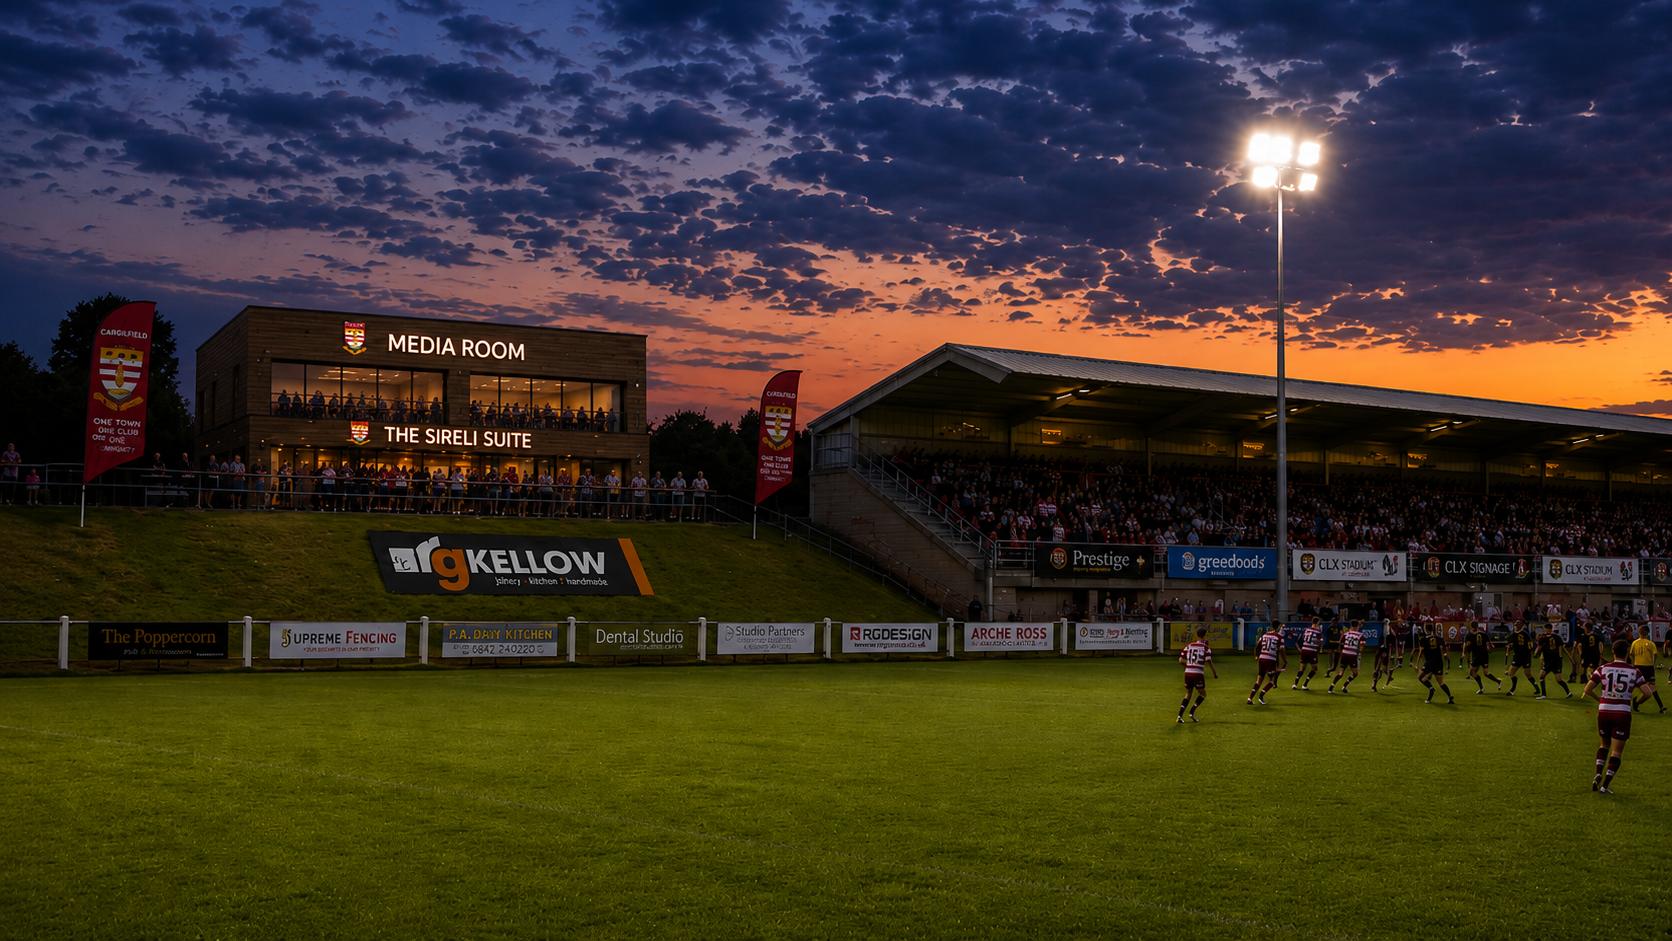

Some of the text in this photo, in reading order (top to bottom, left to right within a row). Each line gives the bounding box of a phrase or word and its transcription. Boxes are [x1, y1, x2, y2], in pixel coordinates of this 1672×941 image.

[388, 333, 525, 361] MEDIA ROOM
[384, 426, 532, 449] THE SIRELI SUITE
[465, 548, 605, 575] KELLOW
[1072, 550, 1130, 571] Prestige
[1319, 558, 1374, 571] CLX STADIUM
[1444, 560, 1510, 575] CLX SIGNAGE
[1565, 563, 1582, 575] CLX
[101, 628, 217, 648] The Poppercorn
[346, 630, 397, 644] FENCING
[448, 628, 471, 641] P.A.
[505, 629, 553, 640] KITCHEN
[596, 628, 638, 644] Dental
[735, 625, 805, 637] Studio Partners
[971, 627, 1047, 640] ARCHE ROSS
[1607, 672, 1629, 694] 15
